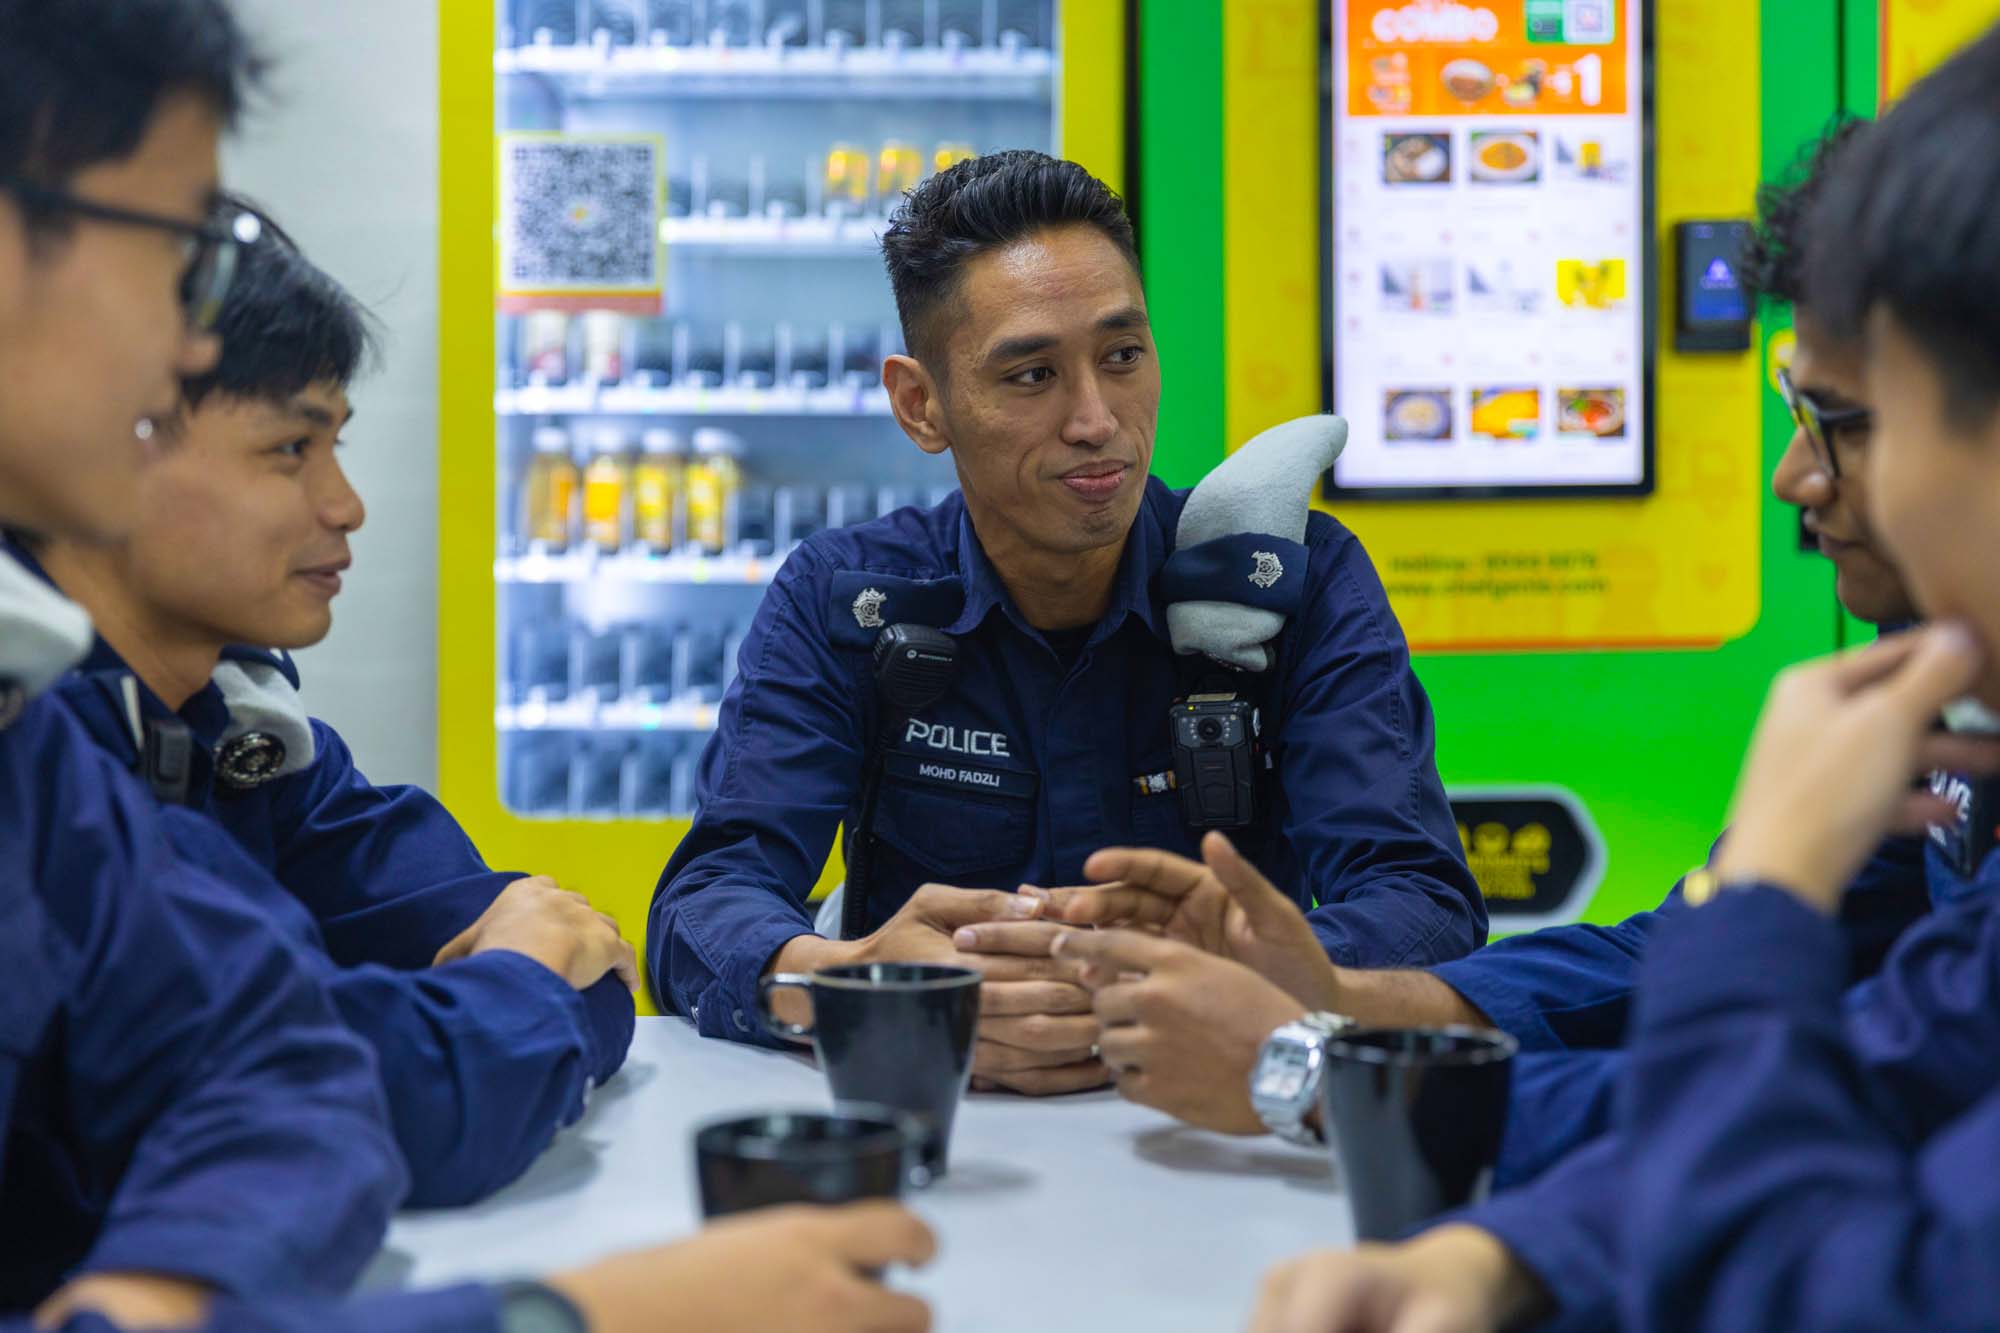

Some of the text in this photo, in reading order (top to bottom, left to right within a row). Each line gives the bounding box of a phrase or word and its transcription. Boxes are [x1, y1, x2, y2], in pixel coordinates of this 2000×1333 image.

[905, 718, 1010, 757] POLICE
[919, 763, 1000, 788] MOHD FADZLI
